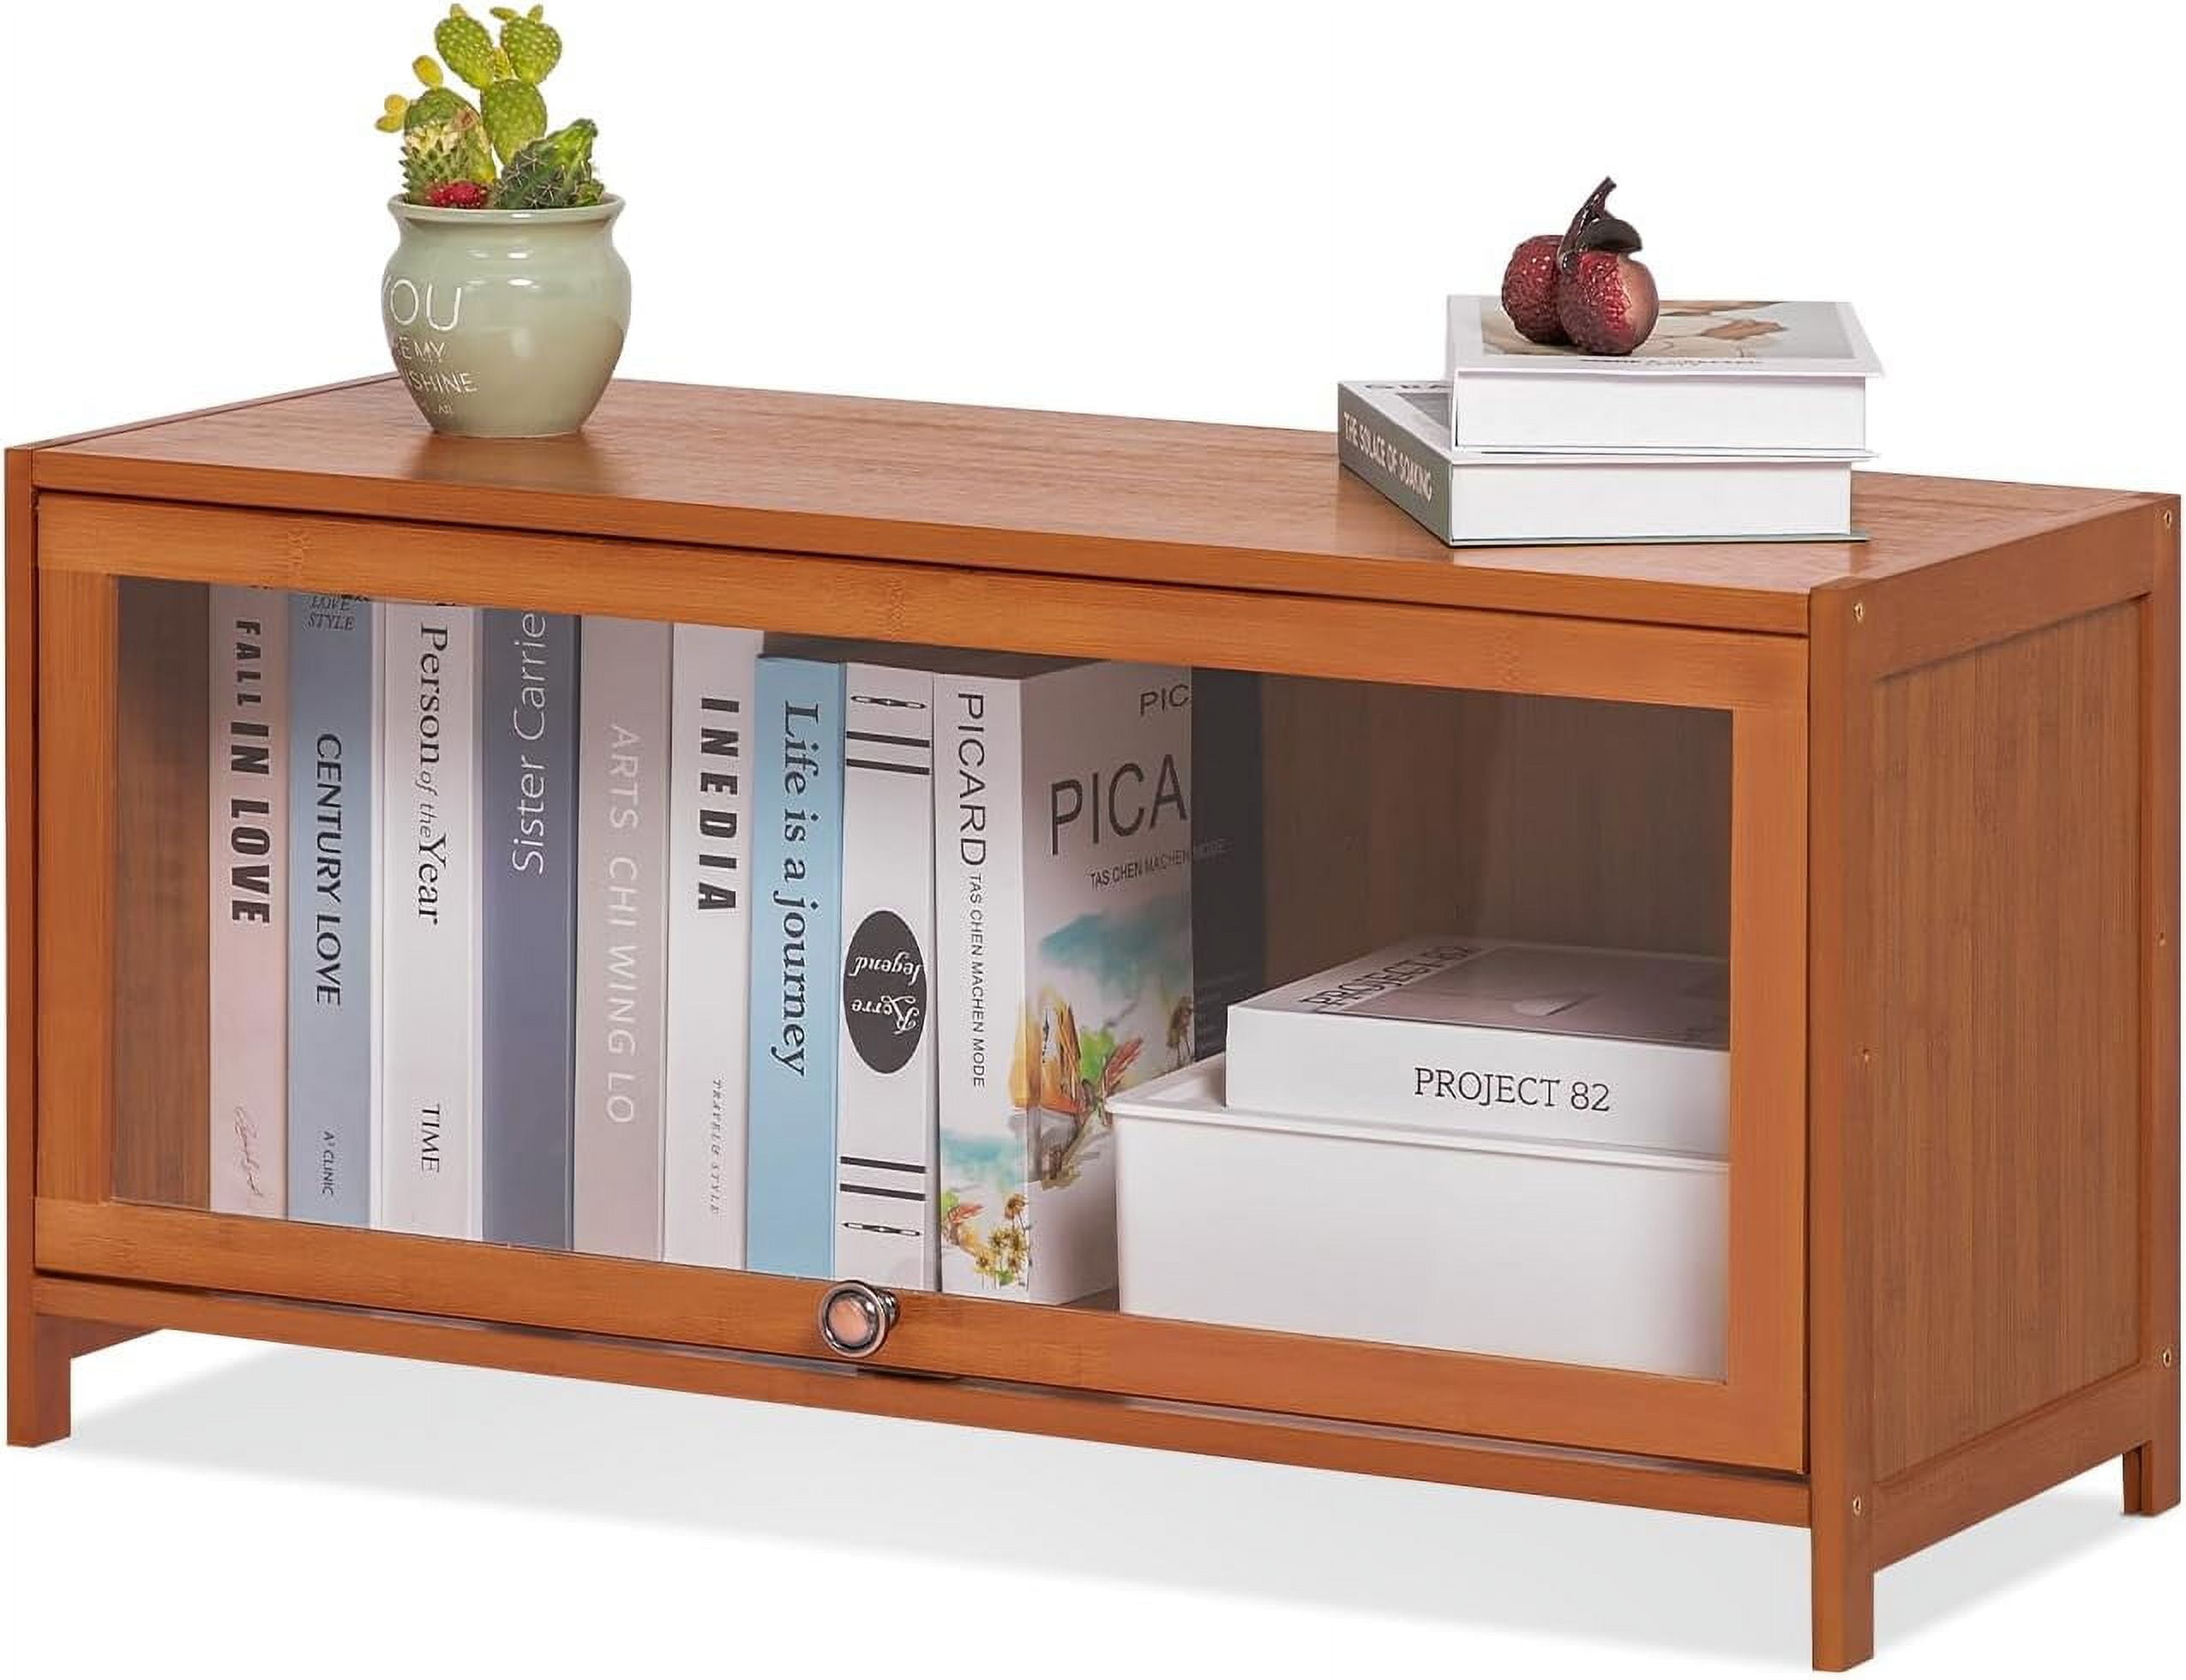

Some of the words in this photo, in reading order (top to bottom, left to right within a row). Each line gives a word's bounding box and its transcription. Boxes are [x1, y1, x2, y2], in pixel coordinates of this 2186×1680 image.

[308, 613, 356, 632] STYLE
[235, 620, 262, 706] FALL
[418, 621, 450, 765] Person
[512, 611, 546, 742] Carrie
[1138, 683, 1190, 717] PIC
[230, 721, 270, 777] IN
[414, 769, 440, 797] of
[607, 723, 643, 830] ARTS
[783, 699, 820, 796] Life
[958, 692, 987, 867] PICARD
[315, 733, 343, 904] CENTURY
[418, 797, 440, 838] the
[511, 753, 546, 876] Sister
[697, 697, 741, 910] INEDIA
[783, 807, 820, 843] is
[1050, 753, 1189, 856] PICA
[230, 797, 271, 924] LOVE
[417, 831, 447, 926] Year
[606, 855, 640, 927] CHI
[783, 855, 808, 884] a
[315, 913, 343, 1006] LOVE
[771, 889, 820, 1077] journey
[847, 950, 923, 986] legend
[970, 961, 986, 1033] MACHEN
[606, 944, 638, 1056] WING
[605, 1071, 635, 1124] LO
[972, 1037, 986, 1087] MODE
[1413, 1066, 1561, 1108] PROJECT
[1570, 1082, 1612, 1113] 82
[321, 1149, 335, 1197] CLINIC
[420, 1103, 441, 1174] TIME
